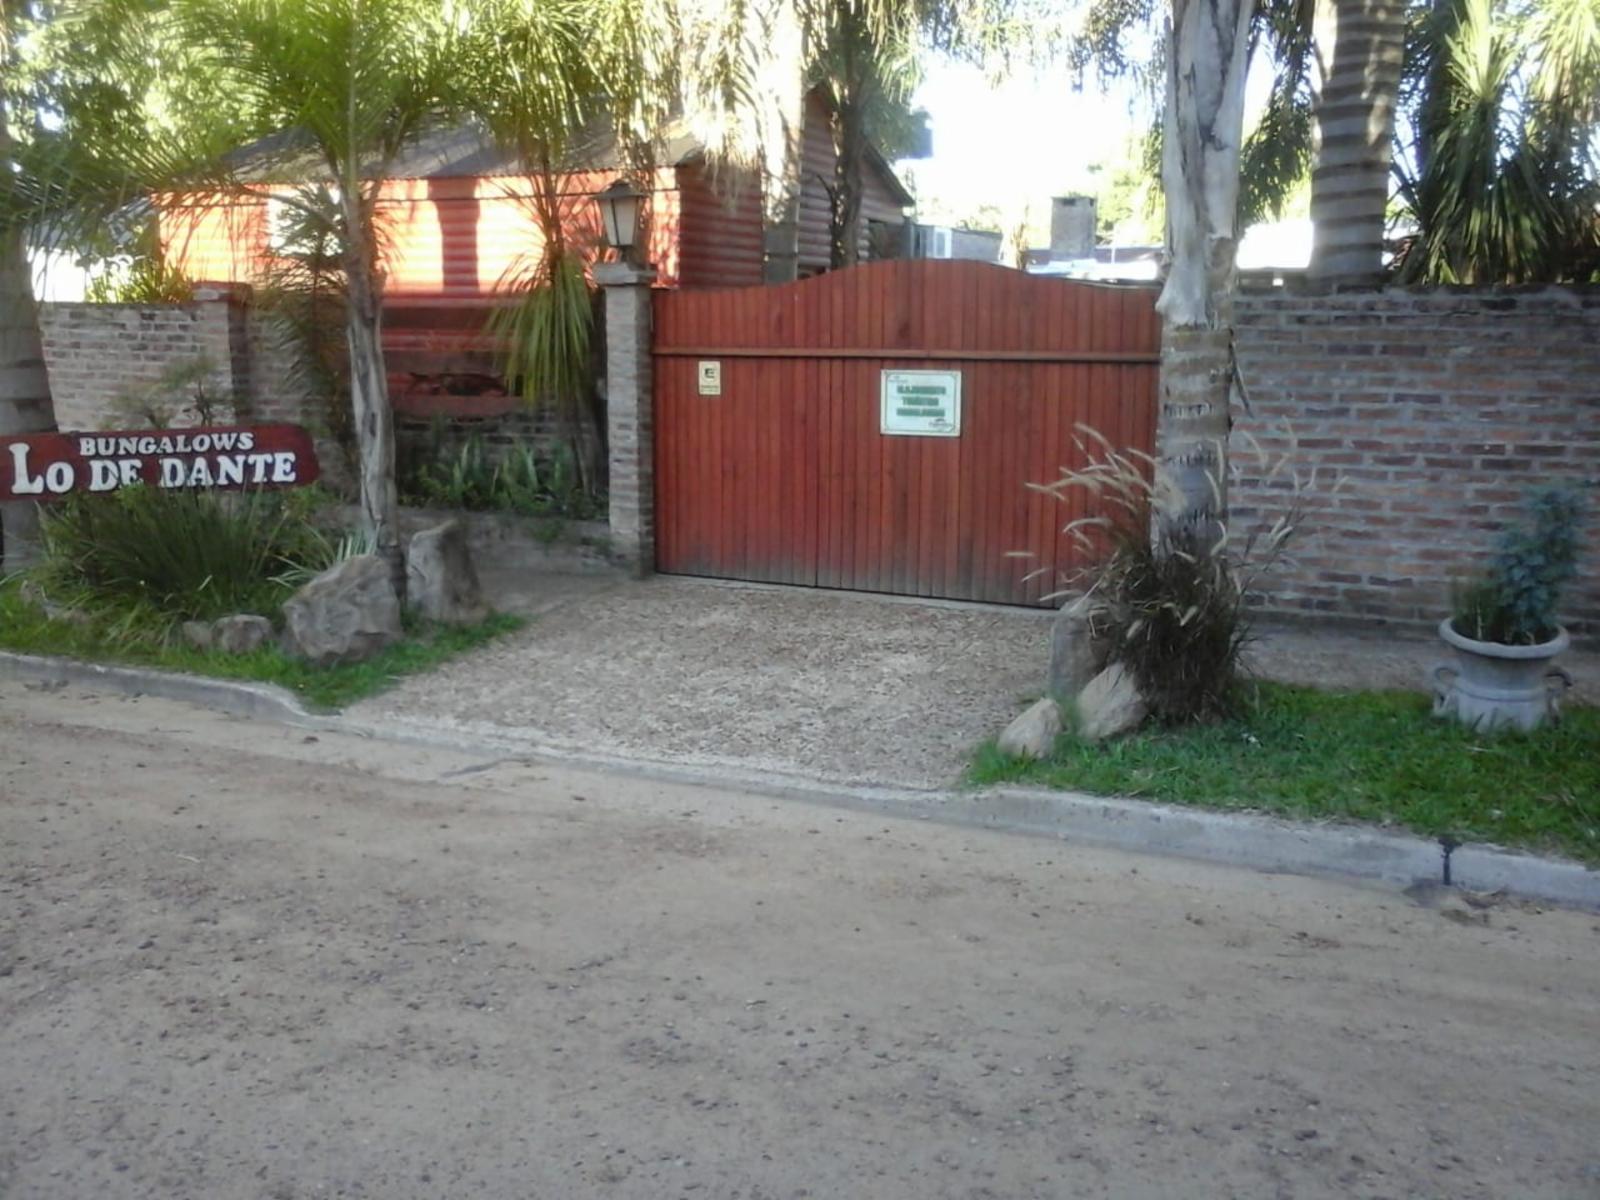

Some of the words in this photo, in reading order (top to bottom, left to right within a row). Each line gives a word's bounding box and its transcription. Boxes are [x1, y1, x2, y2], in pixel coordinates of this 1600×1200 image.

[80, 432, 254, 456] BUNGALOWS
[89, 459, 143, 491] DE
[158, 452, 296, 488] DANTE
